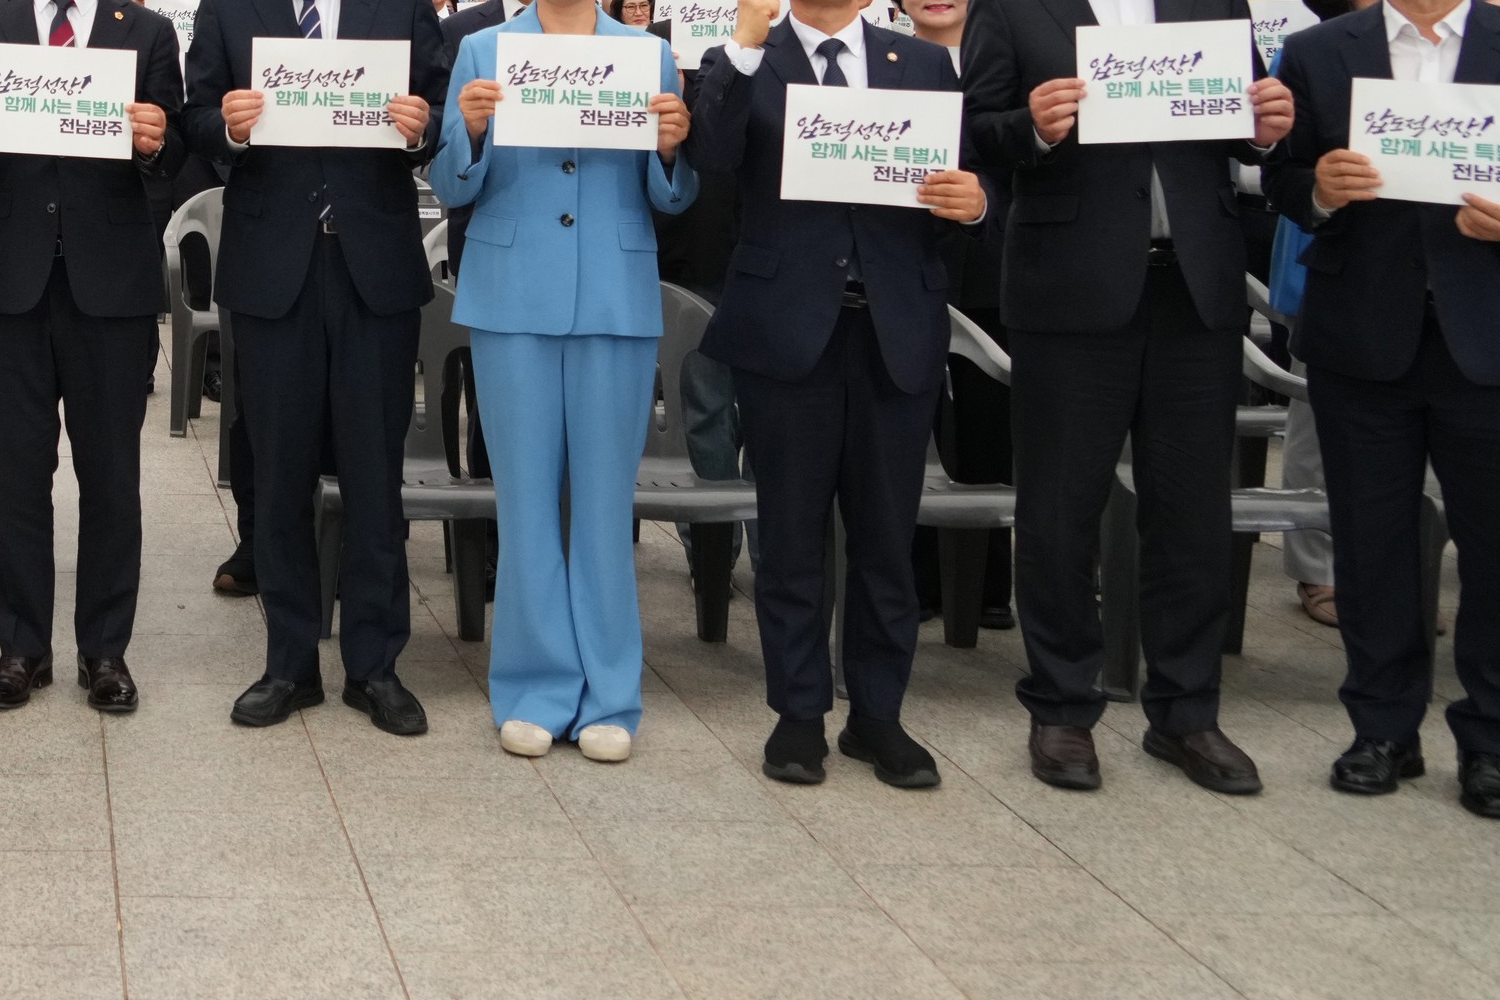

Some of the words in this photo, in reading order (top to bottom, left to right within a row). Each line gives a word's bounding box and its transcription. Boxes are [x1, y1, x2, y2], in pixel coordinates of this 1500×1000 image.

[680, 3, 722, 23] 압도적
[691, 24, 717, 37] 함께
[507, 60, 562, 87] 압도적
[560, 63, 614, 87] 성장!
[1090, 53, 1148, 81] 압도적
[1146, 50, 1203, 76] 성장!
[42, 75, 92, 96] 성장!
[262, 64, 315, 89] 압도적
[313, 66, 365, 89] 성장!
[275, 90, 307, 106] 함께
[312, 91, 345, 107] 사는
[520, 87, 554, 105] 함께
[558, 89, 593, 106] 사는
[598, 90, 649, 108] 특별시
[1106, 80, 1142, 99] 함께
[1146, 79, 1182, 97] 사는
[1187, 77, 1242, 95] 특별시
[4, 96, 36, 113] 함께
[40, 98, 72, 115] 사는
[76, 99, 124, 118] 특별시
[1169, 97, 1243, 117] 전남광주
[59, 118, 123, 136] 전남광주
[580, 109, 648, 127] 전남광주
[797, 113, 855, 142] 압도적
[853, 119, 912, 142] 성장!
[1364, 108, 1431, 138] 압도적
[1429, 115, 1495, 138] 성장!
[811, 141, 847, 160] 함께
[851, 144, 888, 162] 사는
[893, 146, 948, 165] 특별시
[1381, 138, 1421, 157] 함께
[1426, 141, 1468, 160] 사는
[873, 165, 946, 184] 전남광
[1452, 163, 1500, 182] 전남
